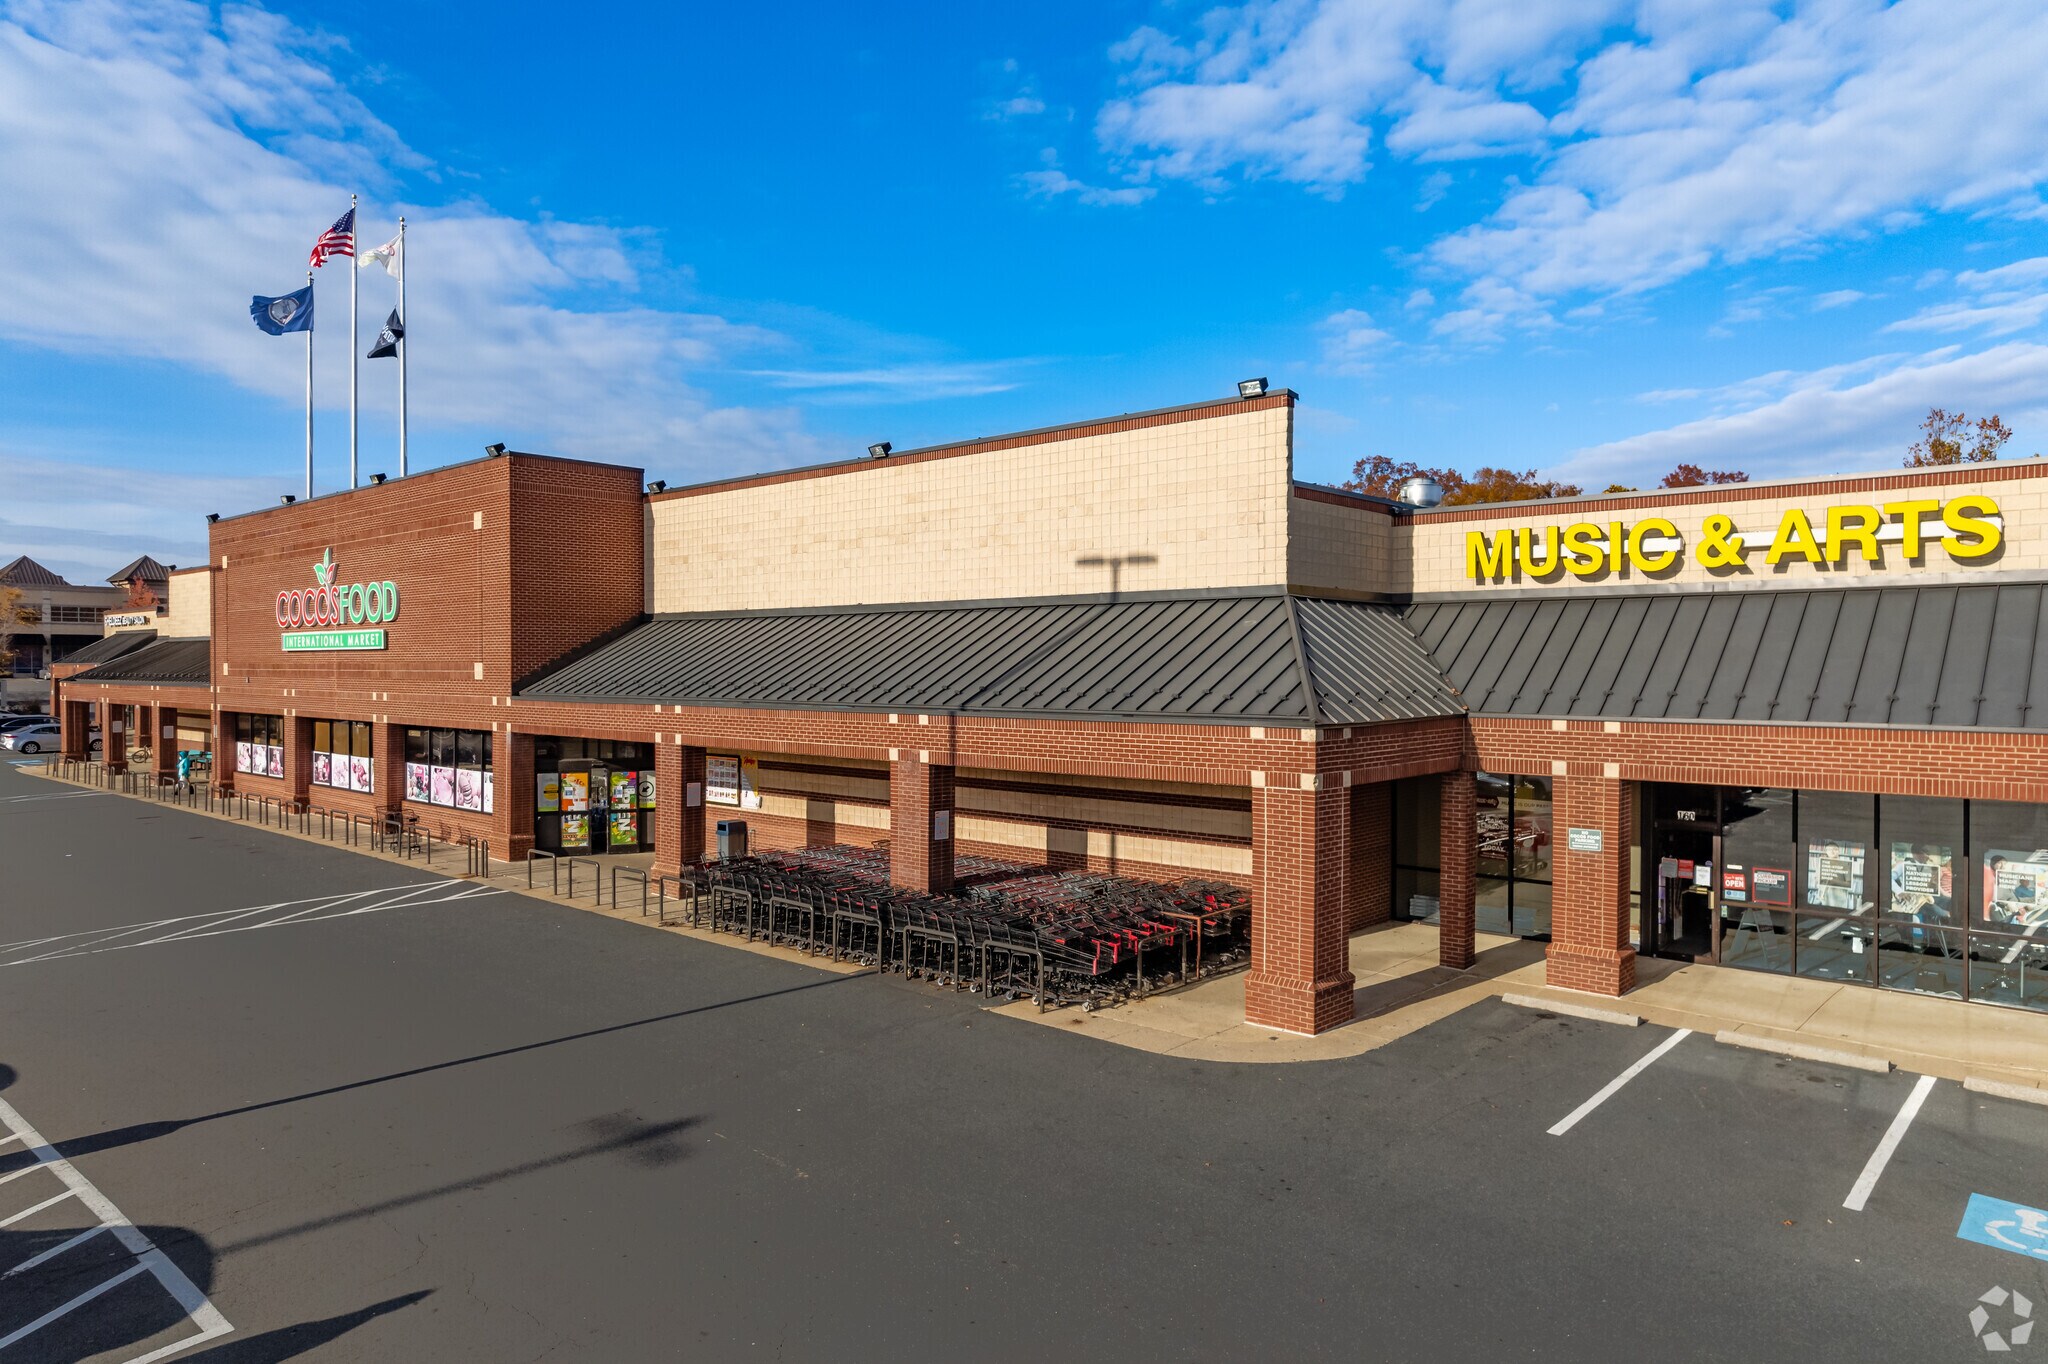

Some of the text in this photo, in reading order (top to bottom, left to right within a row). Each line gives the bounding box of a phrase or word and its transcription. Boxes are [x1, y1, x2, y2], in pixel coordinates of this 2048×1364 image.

[1465, 495, 2004, 579] MUSIC & ARTS
[286, 633, 379, 647] INTERNATIONAL MARKET
[1725, 880, 1744, 888] OPEN
